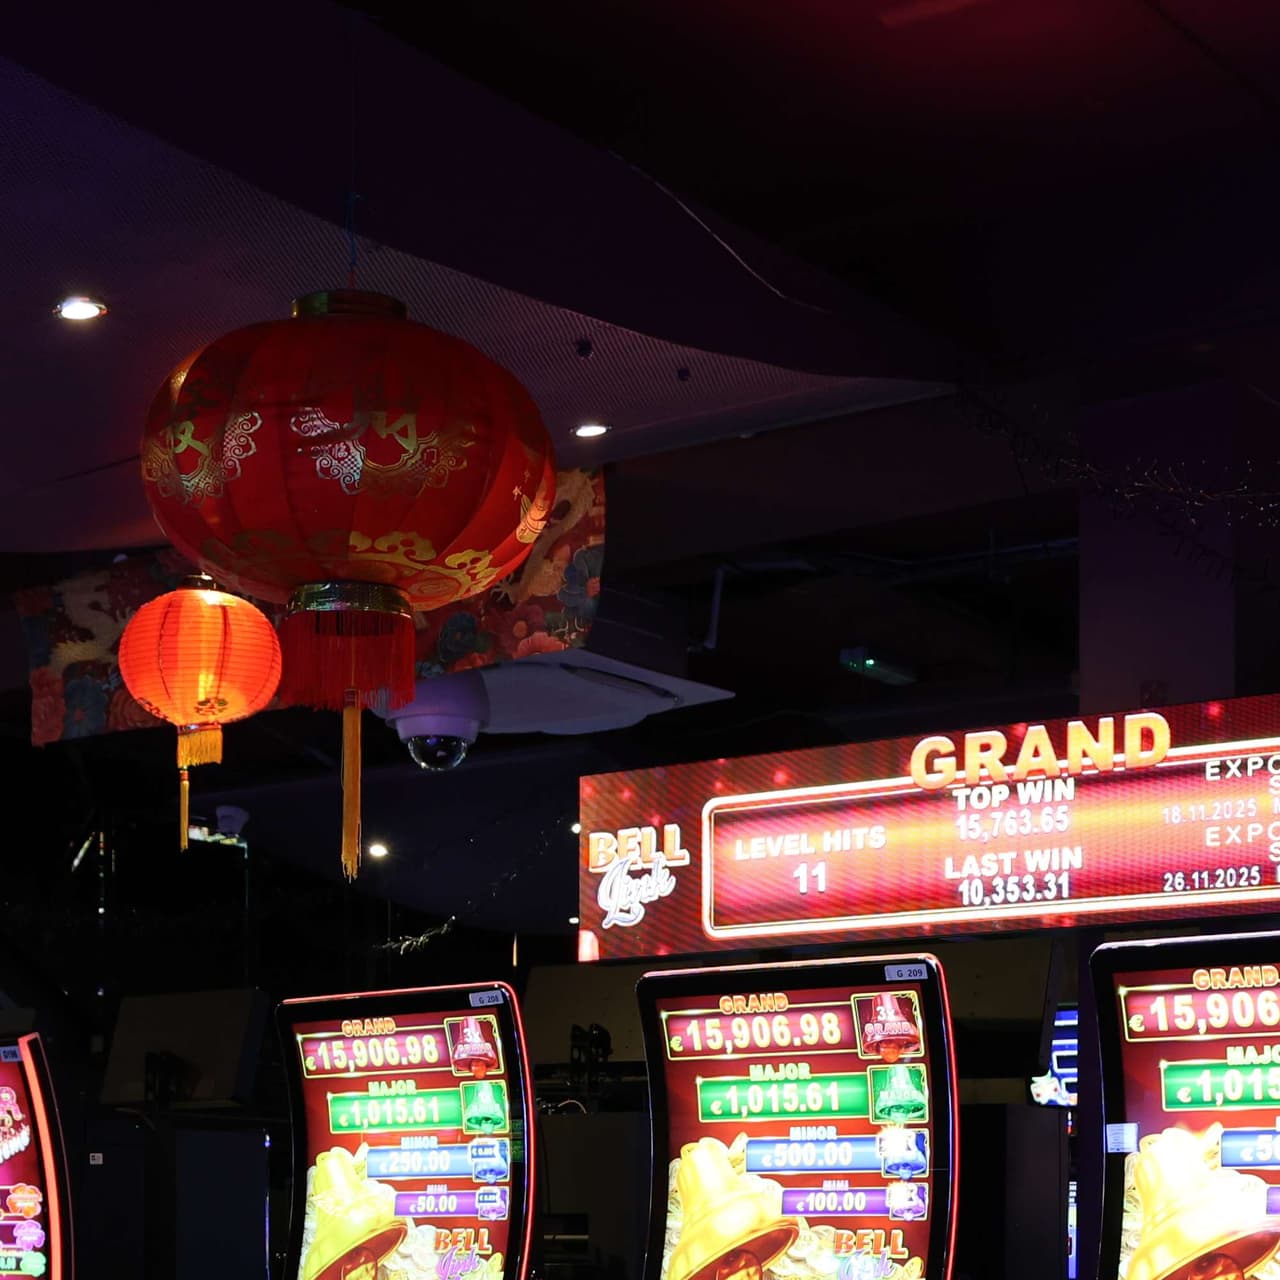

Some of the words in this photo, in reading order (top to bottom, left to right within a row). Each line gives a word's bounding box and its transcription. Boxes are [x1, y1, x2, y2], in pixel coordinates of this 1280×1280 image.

[910, 712, 1170, 790] GRAND
[952, 784, 1009, 810] TOP
[1017, 777, 1075, 804] WIN
[956, 805, 1069, 842] 15,763.65
[1162, 798, 1257, 824] 18.11.2025
[589, 824, 690, 873] BELL
[735, 832, 815, 860] LEVEL
[823, 825, 887, 852] HITS
[793, 861, 827, 894] 11
[945, 851, 1017, 879] LAST
[1024, 846, 1082, 872] WIN
[1163, 866, 1261, 892] 26.11.2025
[598, 859, 676, 928] Link
[958, 871, 1070, 906] 10,353.31
[897, 969, 904, 978] G
[907, 968, 923, 978] 209
[1193, 965, 1280, 989] GRAND
[720, 993, 789, 1014] GRAND
[686, 1012, 842, 1054] 15,906.98
[749, 1063, 812, 1081] MAJOR
[434, 1228, 492, 1255] BELL
[834, 1229, 909, 1259] BELL
